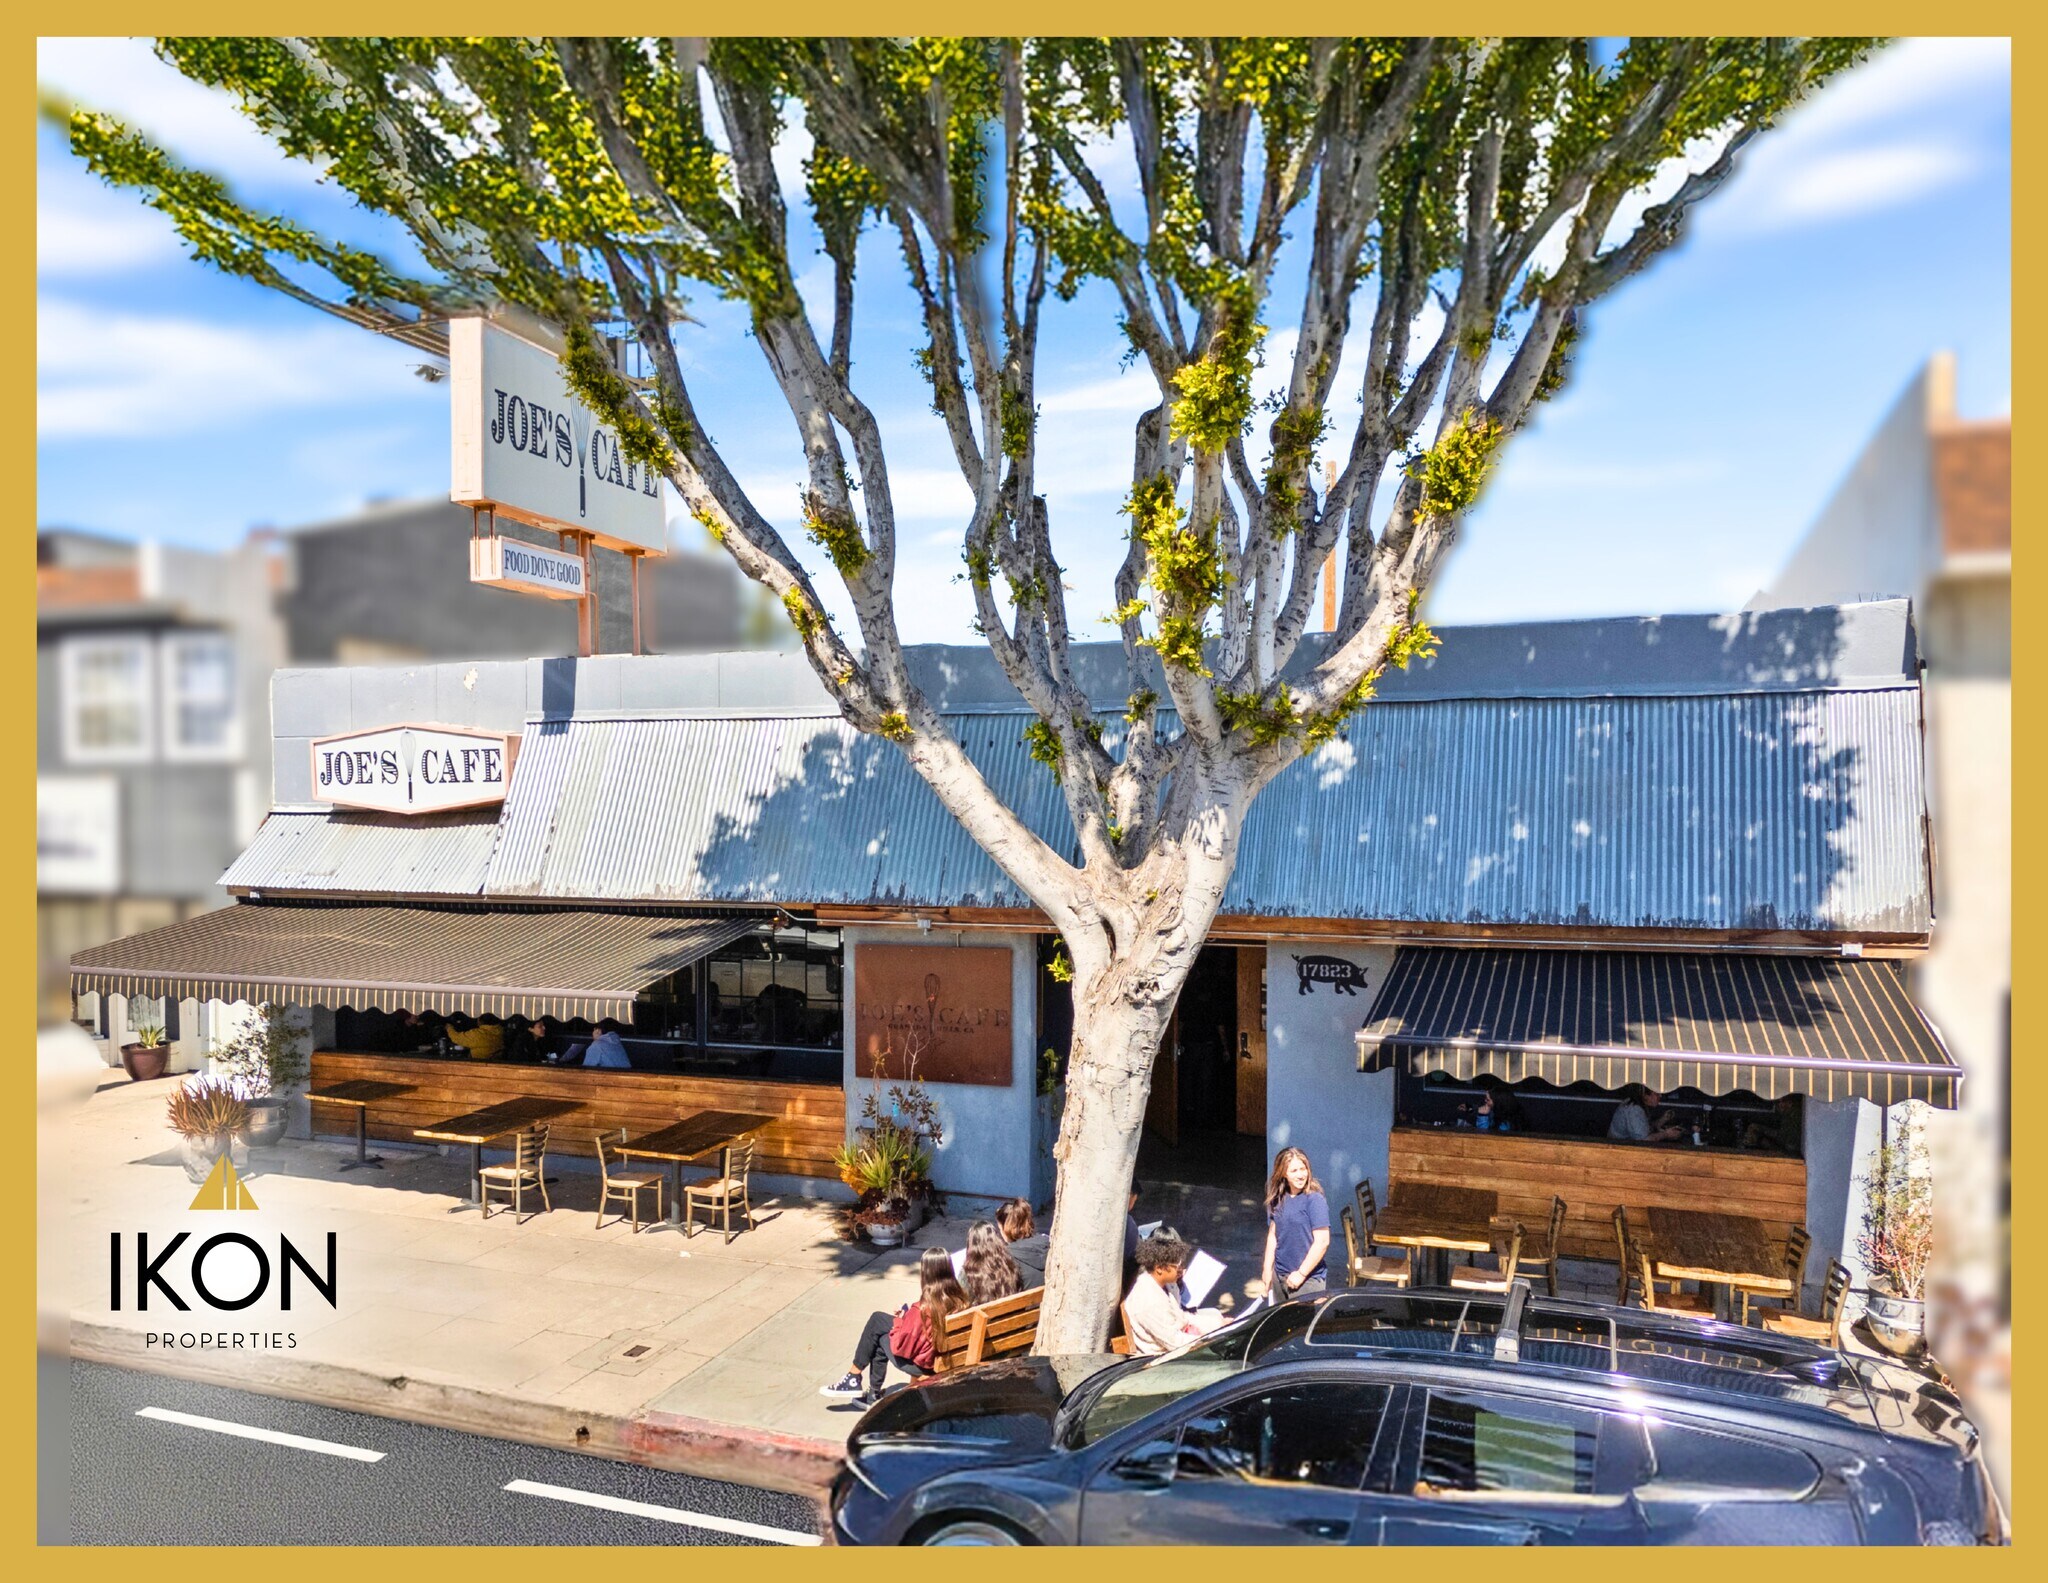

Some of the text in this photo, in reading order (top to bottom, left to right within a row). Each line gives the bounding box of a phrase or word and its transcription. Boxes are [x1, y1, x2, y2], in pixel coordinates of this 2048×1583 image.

[491, 388, 573, 468] JOE'S
[504, 549, 581, 586] FOOD DONE GOOD
[320, 748, 502, 786] JOE'S CAFE
[1302, 964, 1352, 978] 17823
